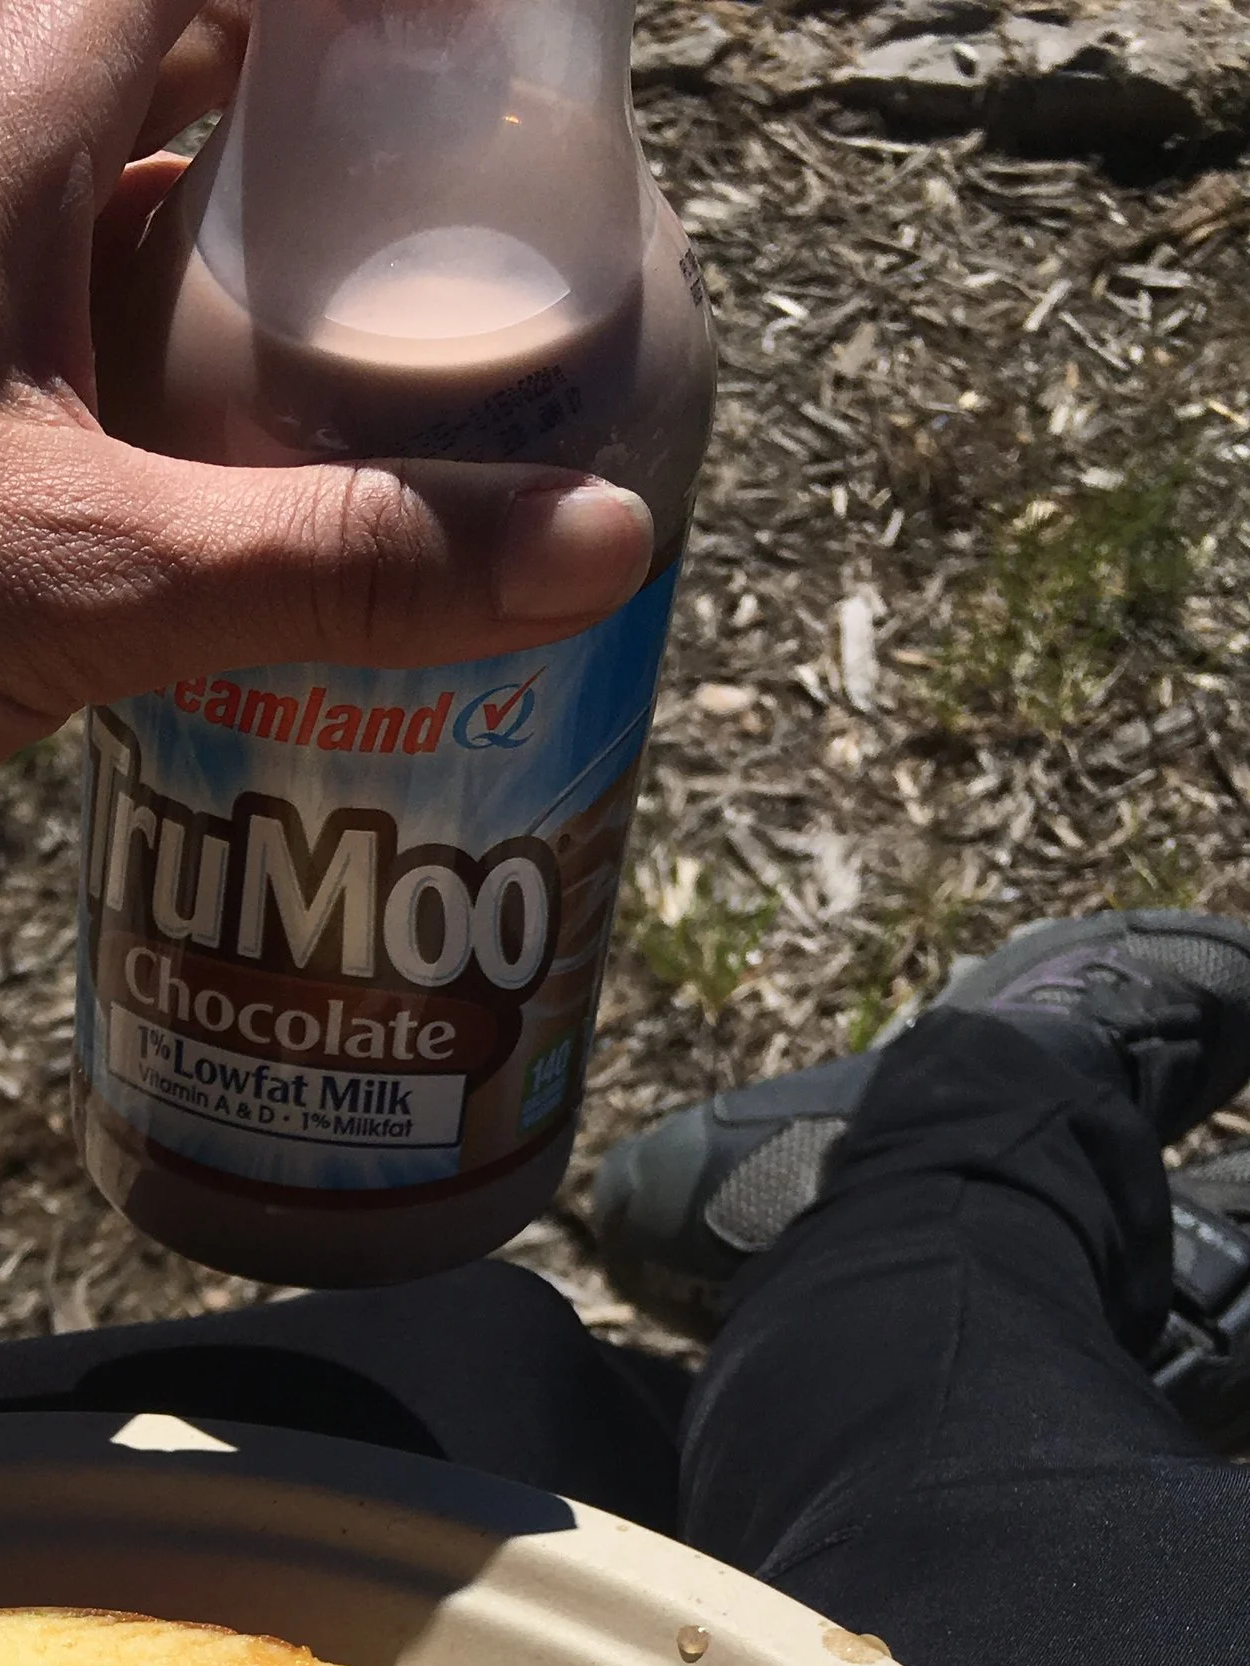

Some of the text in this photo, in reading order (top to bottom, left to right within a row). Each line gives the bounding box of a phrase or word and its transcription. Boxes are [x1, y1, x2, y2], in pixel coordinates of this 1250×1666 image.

[152, 676, 456, 755] eamland
[88, 708, 549, 990] TruMoo
[124, 945, 457, 1061] Chocolate
[138, 1062, 209, 1108] Vitamin
[214, 1095, 230, 1115] A
[236, 1104, 253, 1121] &
[258, 1106, 275, 1124] D
[173, 1039, 308, 1108] Lowfat
[321, 1076, 414, 1117] Milk
